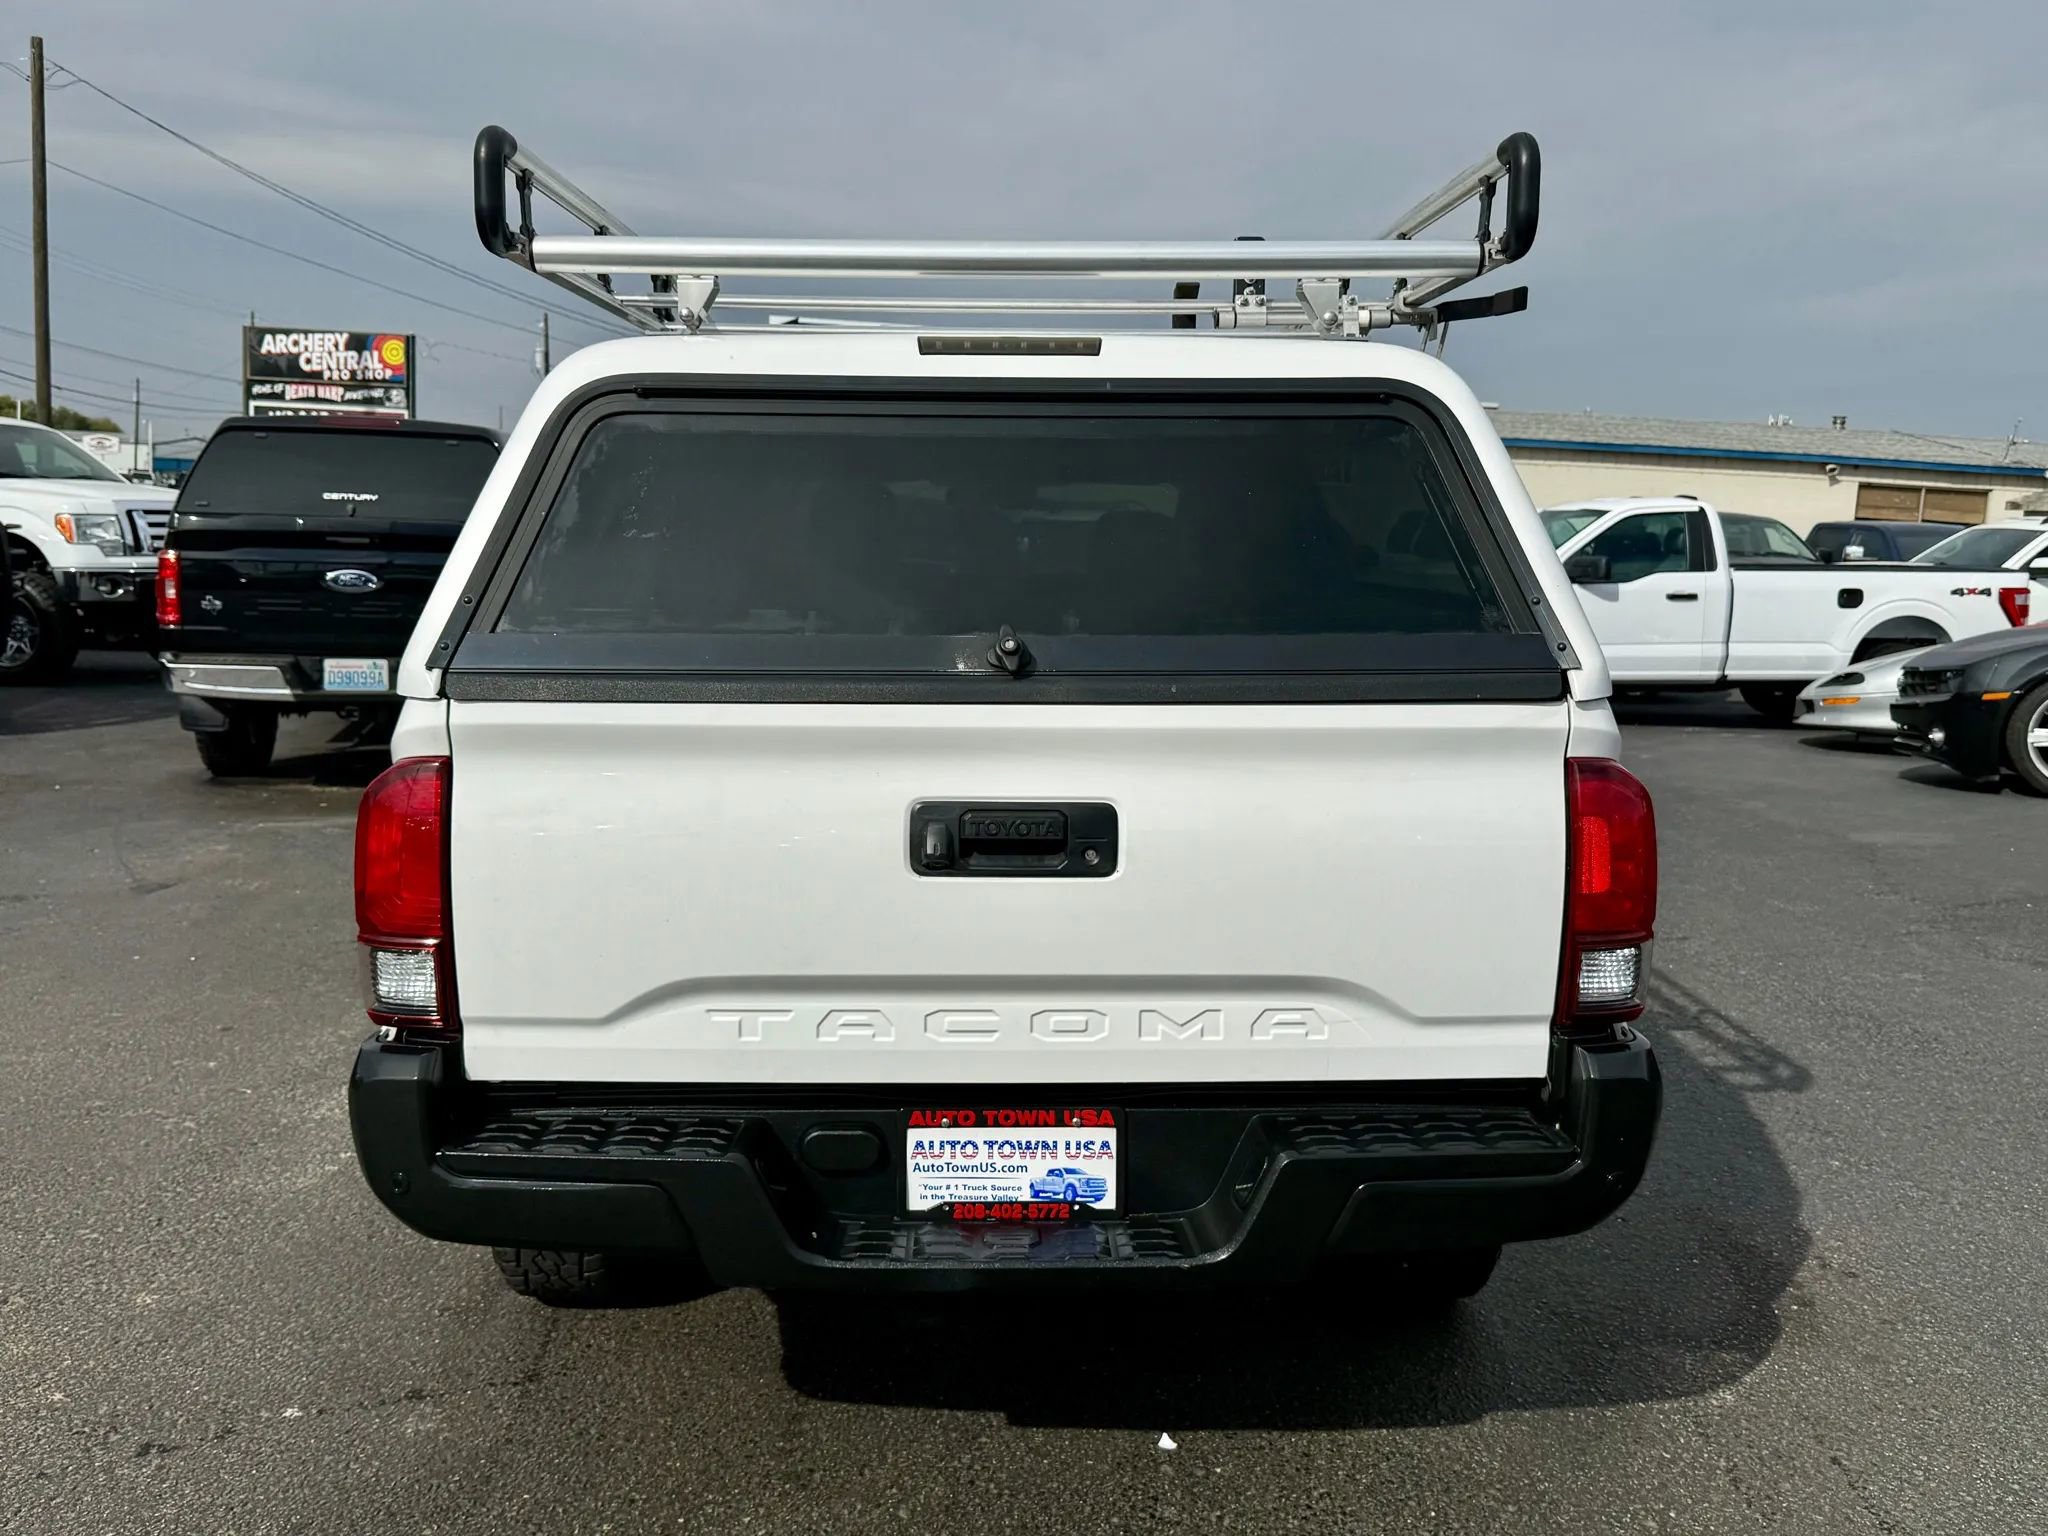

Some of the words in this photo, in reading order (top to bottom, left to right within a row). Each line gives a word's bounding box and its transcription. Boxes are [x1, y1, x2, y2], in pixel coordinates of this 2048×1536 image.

[261, 332, 350, 354] ARCHERY
[299, 351, 383, 371] CENTRAL
[323, 369, 351, 381] PRO
[356, 368, 393, 380] SHOP
[322, 492, 379, 501] CENTURY
[970, 819, 1060, 837] TOYOTA
[705, 1008, 1329, 1042] TACOMA
[908, 1109, 976, 1126] AUTO
[983, 1109, 1056, 1126] TOWN
[1064, 1109, 1115, 1126] USA
[911, 1140, 979, 1160] AUTO
[983, 1140, 1058, 1160] TOWN
[1065, 1140, 1114, 1160] USA
[913, 1162, 1028, 1173] AutoTownUS.com
[953, 1203, 1070, 1220] 208-402-5772
